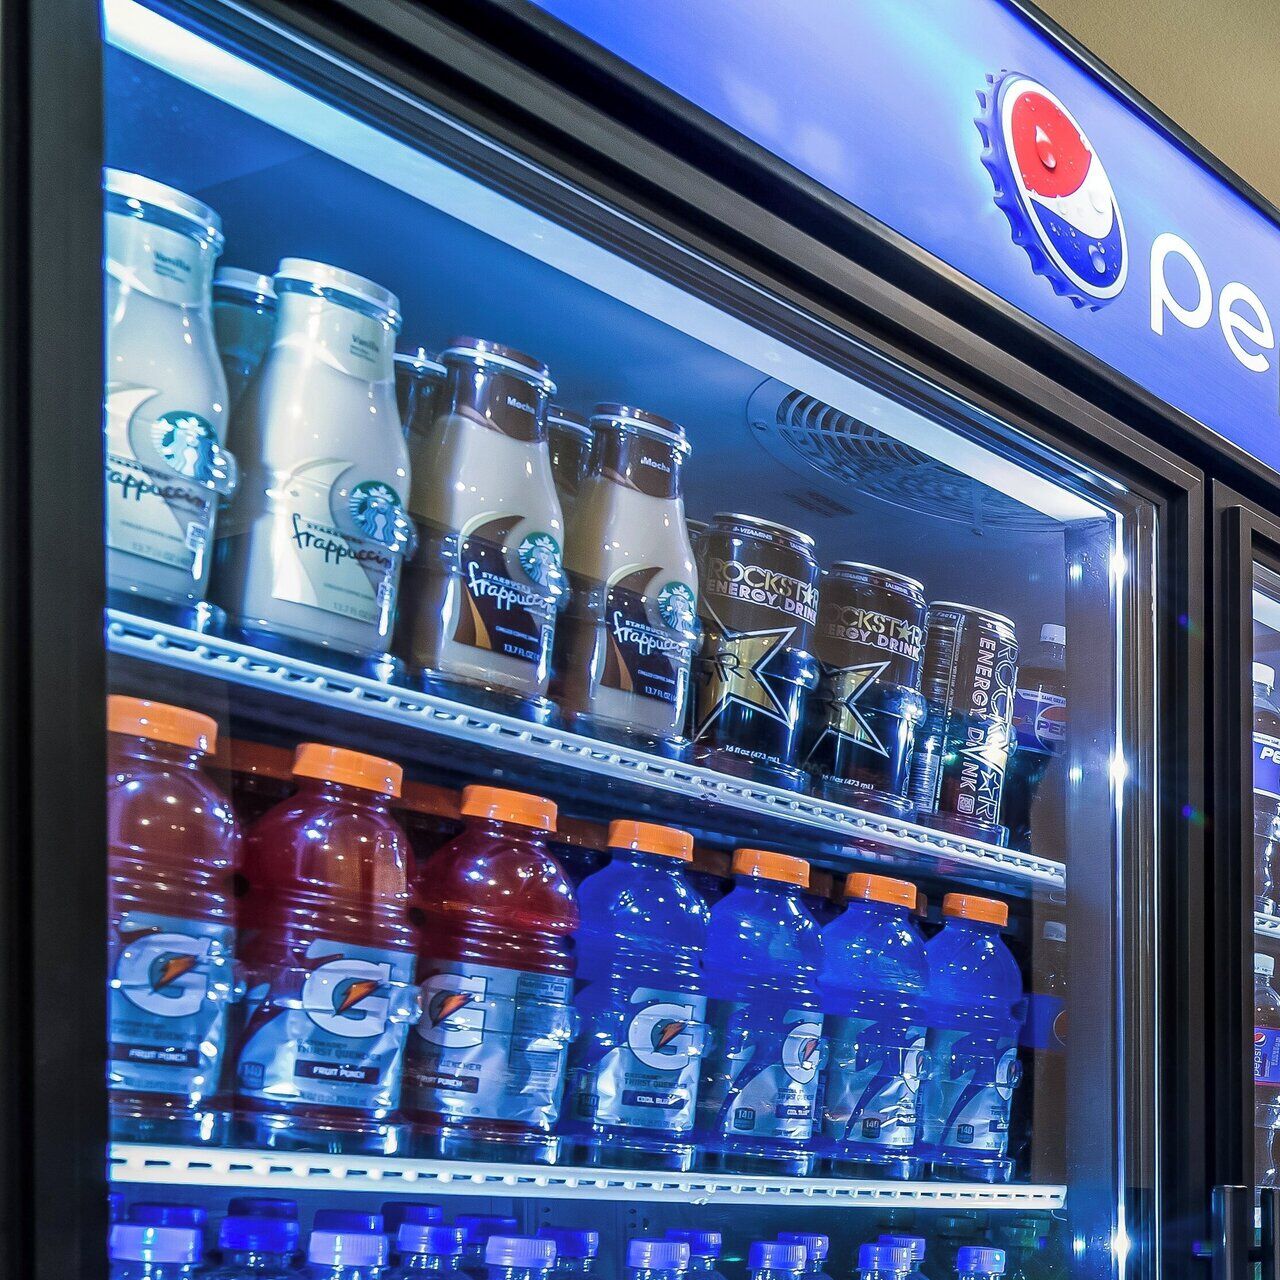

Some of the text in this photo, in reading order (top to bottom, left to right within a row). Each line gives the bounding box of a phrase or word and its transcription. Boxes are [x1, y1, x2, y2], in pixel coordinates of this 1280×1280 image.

[507, 395, 536, 415] Mocha
[641, 455, 671, 474] Mocha
[968, 636, 997, 721] ENERGY
